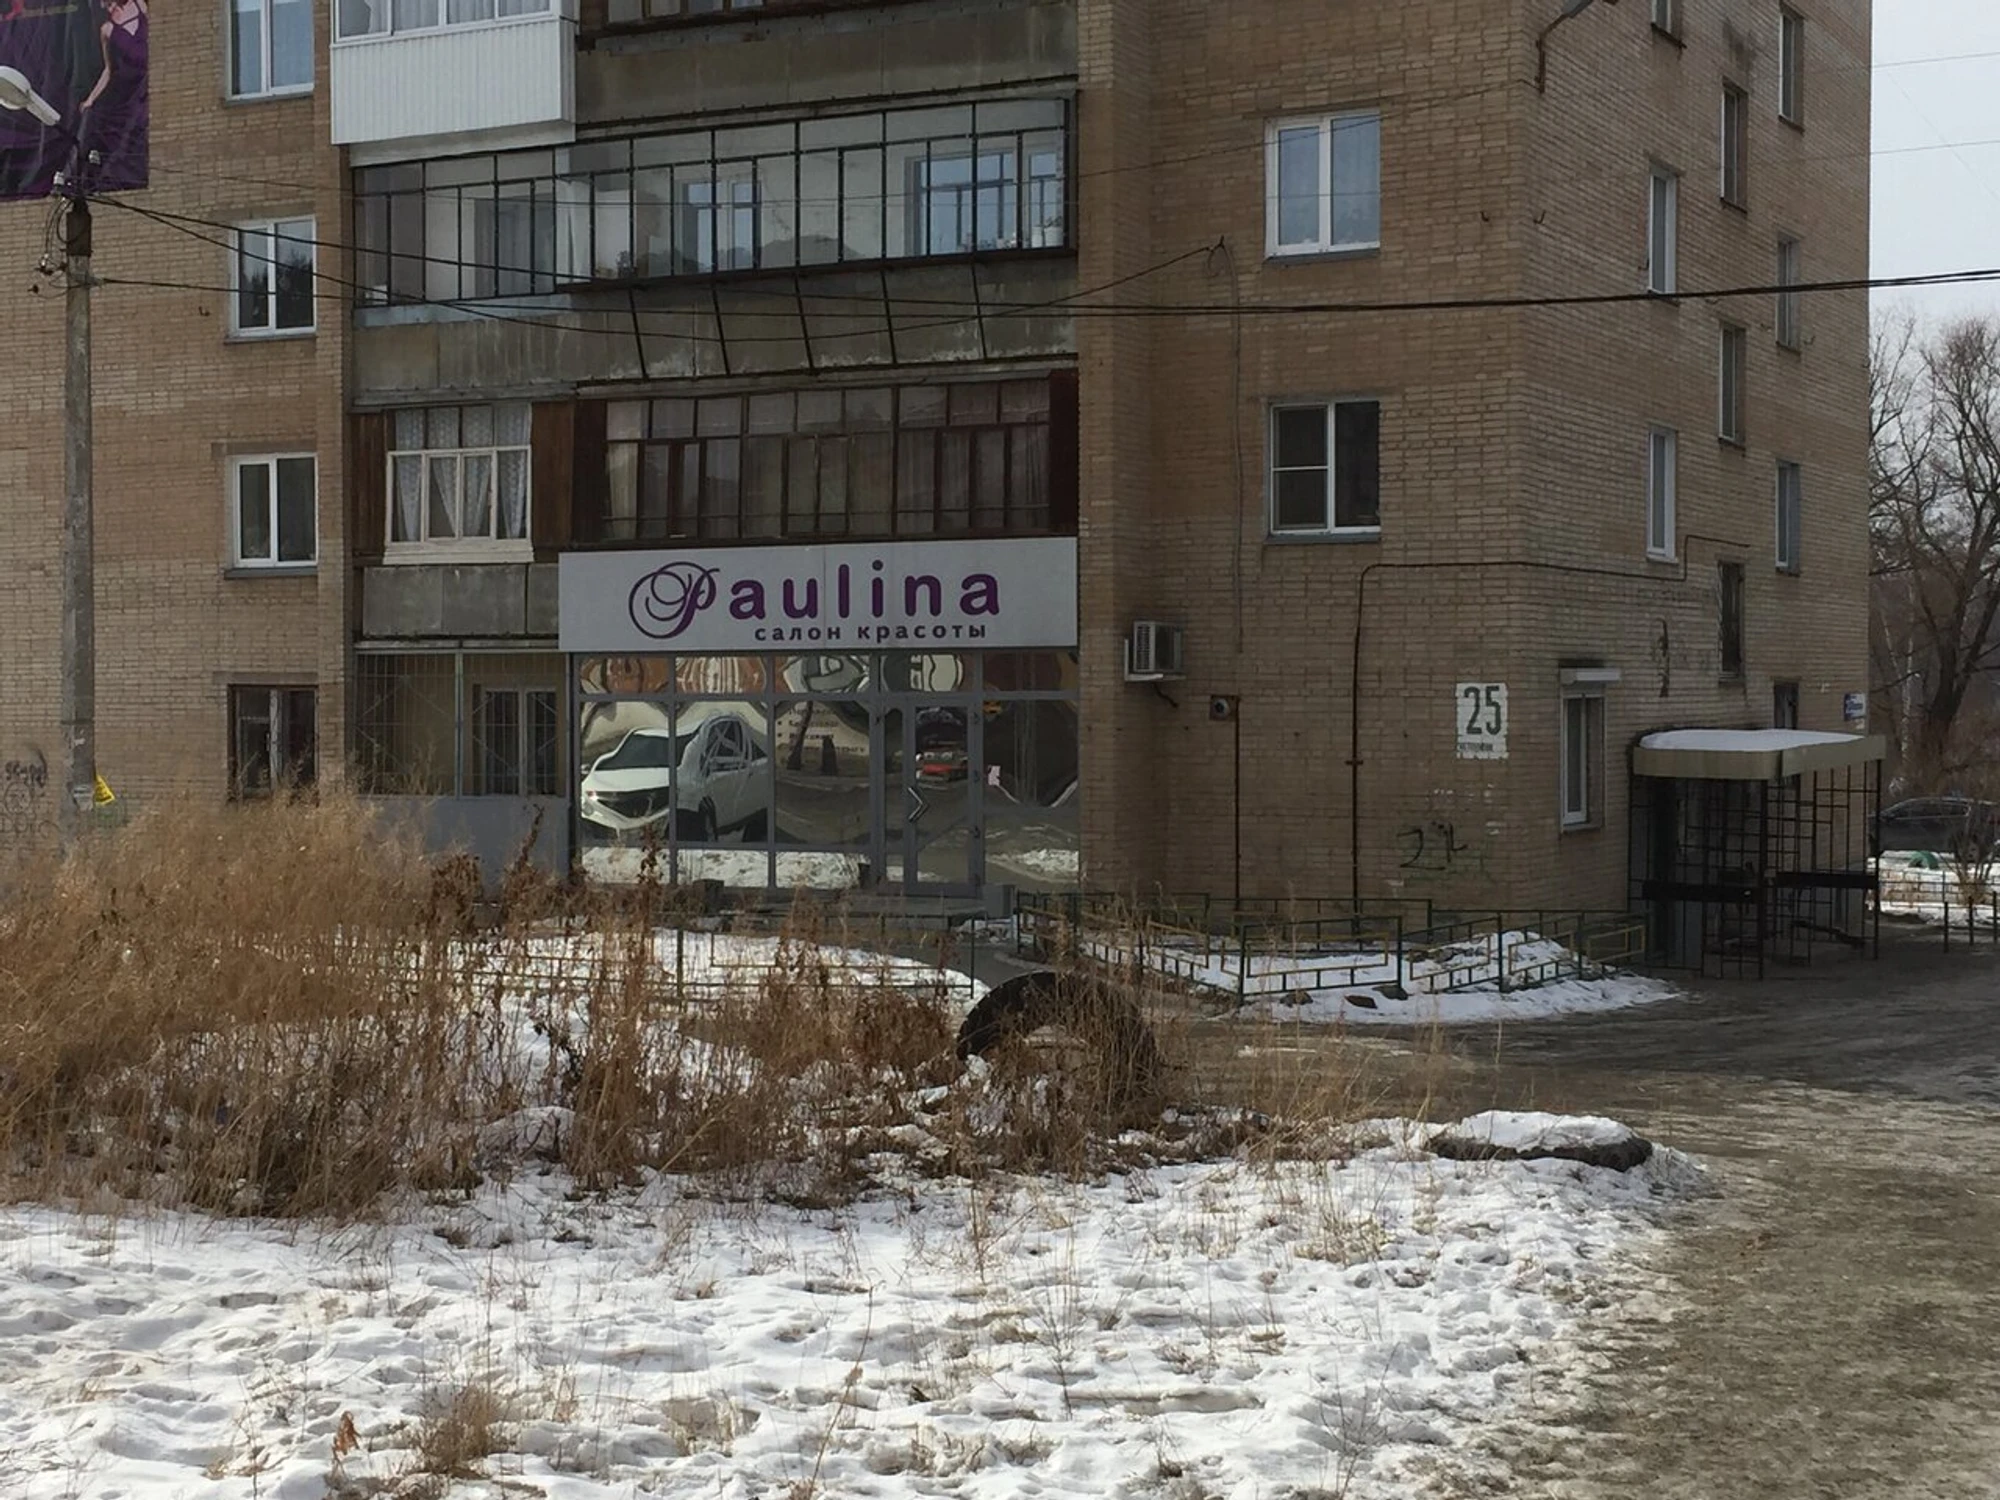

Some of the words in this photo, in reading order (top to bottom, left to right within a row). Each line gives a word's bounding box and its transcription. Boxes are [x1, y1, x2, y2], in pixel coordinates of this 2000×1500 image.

[629, 560, 1000, 639] Paulina
[754, 623, 842, 641] салон
[857, 622, 986, 644] красоты
[1464, 685, 1502, 736] 25
